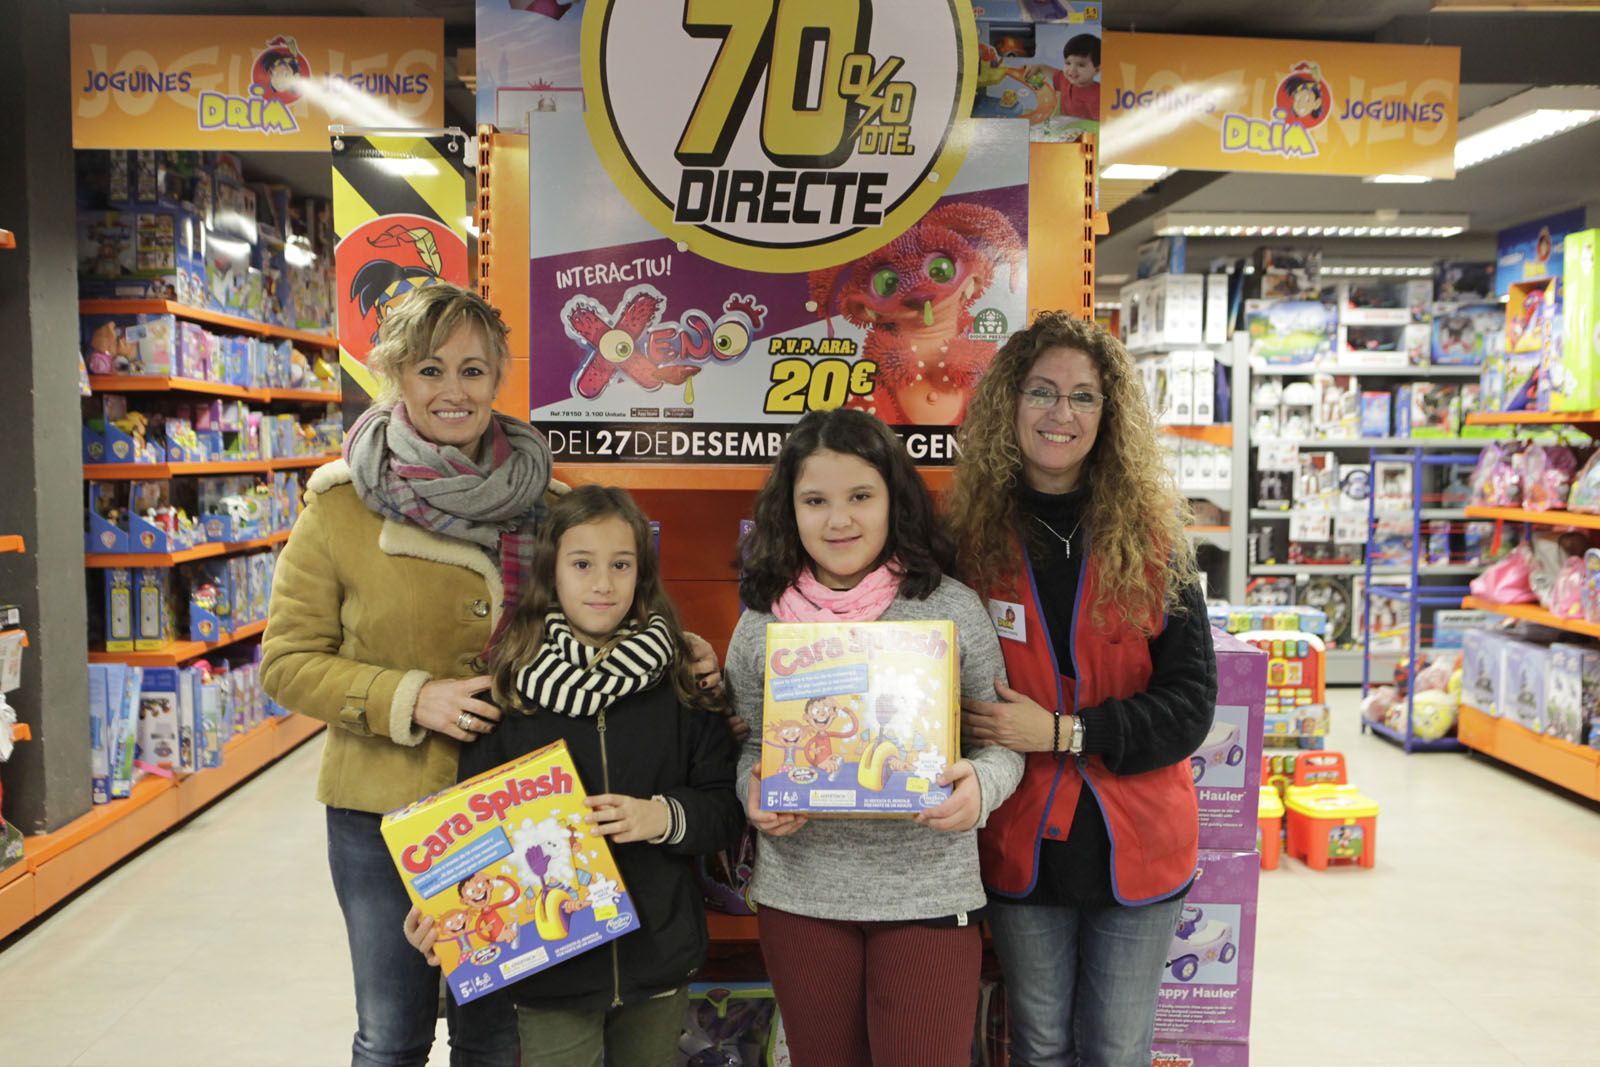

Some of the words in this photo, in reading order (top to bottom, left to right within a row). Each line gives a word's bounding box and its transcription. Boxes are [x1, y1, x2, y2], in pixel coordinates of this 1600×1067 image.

[83, 69, 192, 93] JOGUINES
[1340, 98, 1446, 123] JOGUINES
[858, 124, 916, 156] DTE.
[674, 169, 889, 224] DIRECTE
[556, 254, 672, 289] INTERACTIU!
[768, 337, 817, 355] P.V.P.
[817, 338, 857, 356] ARA:
[763, 357, 878, 414] 20€
[596, 430, 632, 456] 27
[770, 636, 844, 677] Cara
[1200, 790, 1243, 801] Hauler
[401, 812, 473, 874] Cara
[468, 766, 573, 822] Splash
[1158, 988, 1189, 999] appy
[1193, 988, 1236, 998] Hauler
